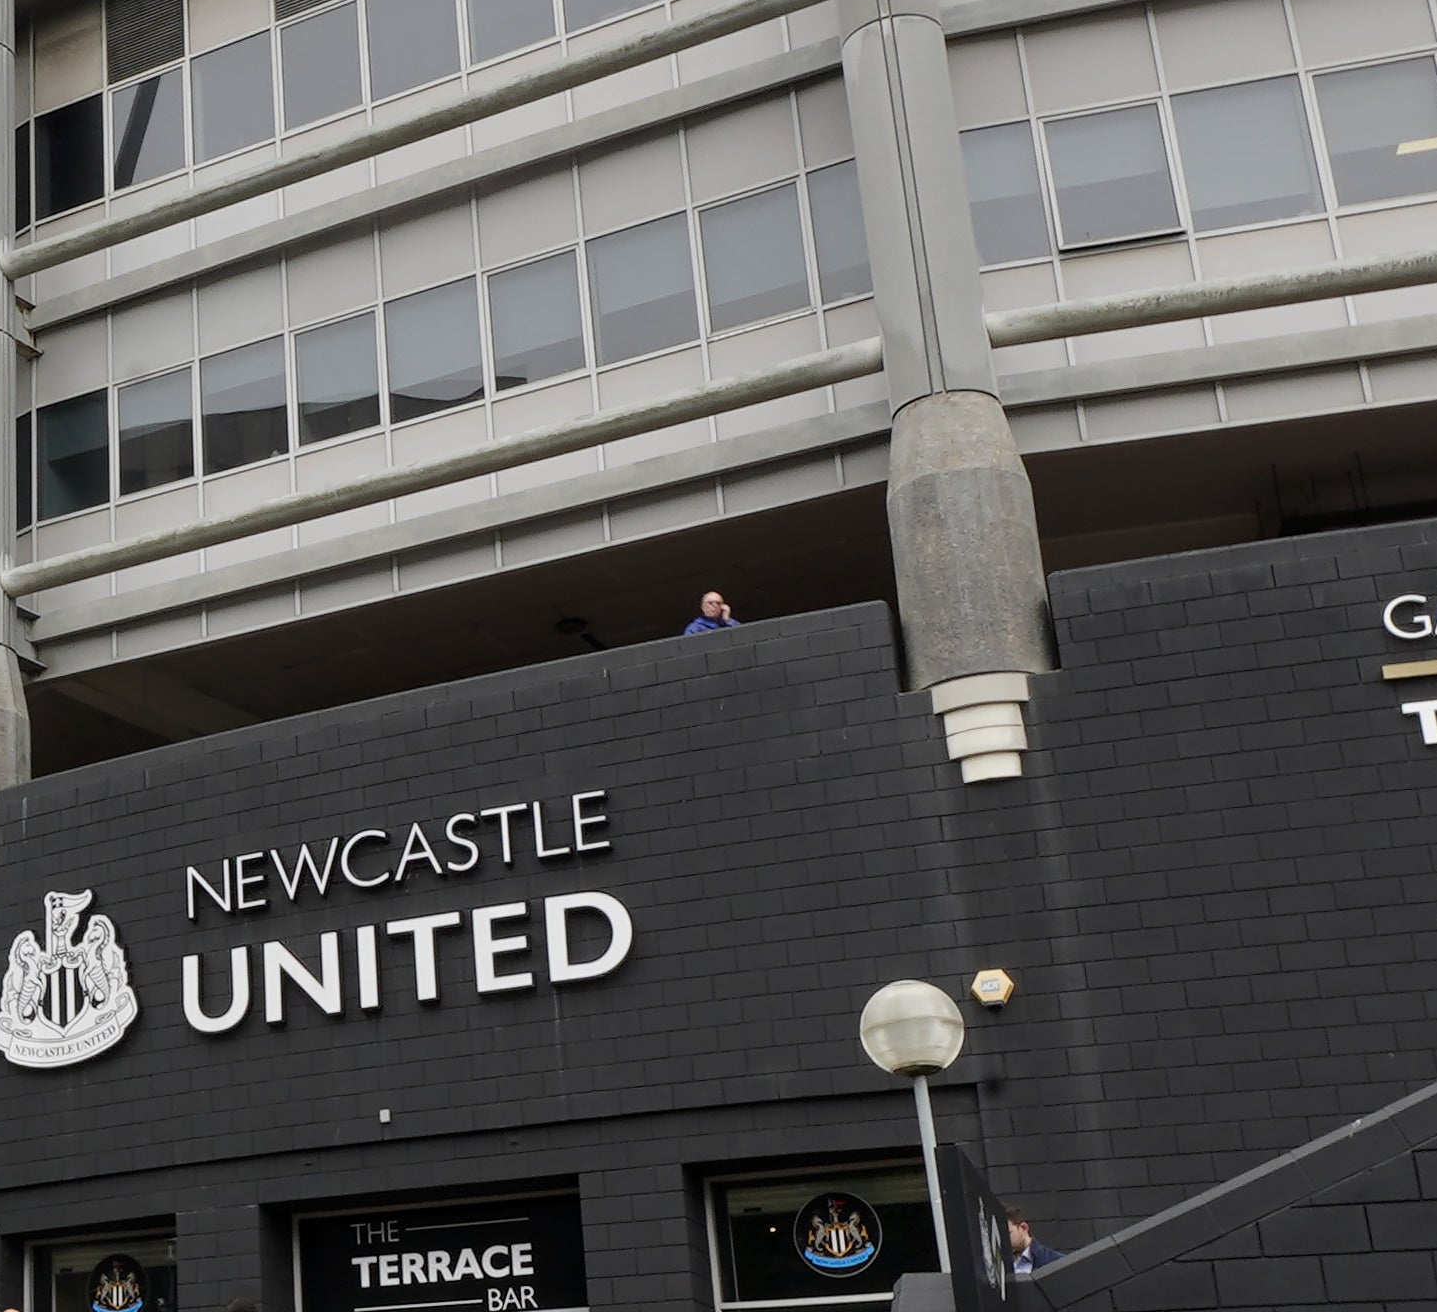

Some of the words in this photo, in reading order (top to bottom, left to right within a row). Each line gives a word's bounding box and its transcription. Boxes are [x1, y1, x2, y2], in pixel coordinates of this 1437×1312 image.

[186, 789, 611, 919] NEWCASTLE
[181, 890, 634, 1035] UNITED
[13, 1043, 76, 1058] NEWCASTLE
[76, 1024, 116, 1052] UNITED
[349, 1219, 400, 1245] THE
[350, 1242, 535, 1288] TERRACE
[487, 1285, 539, 1312] BAR
